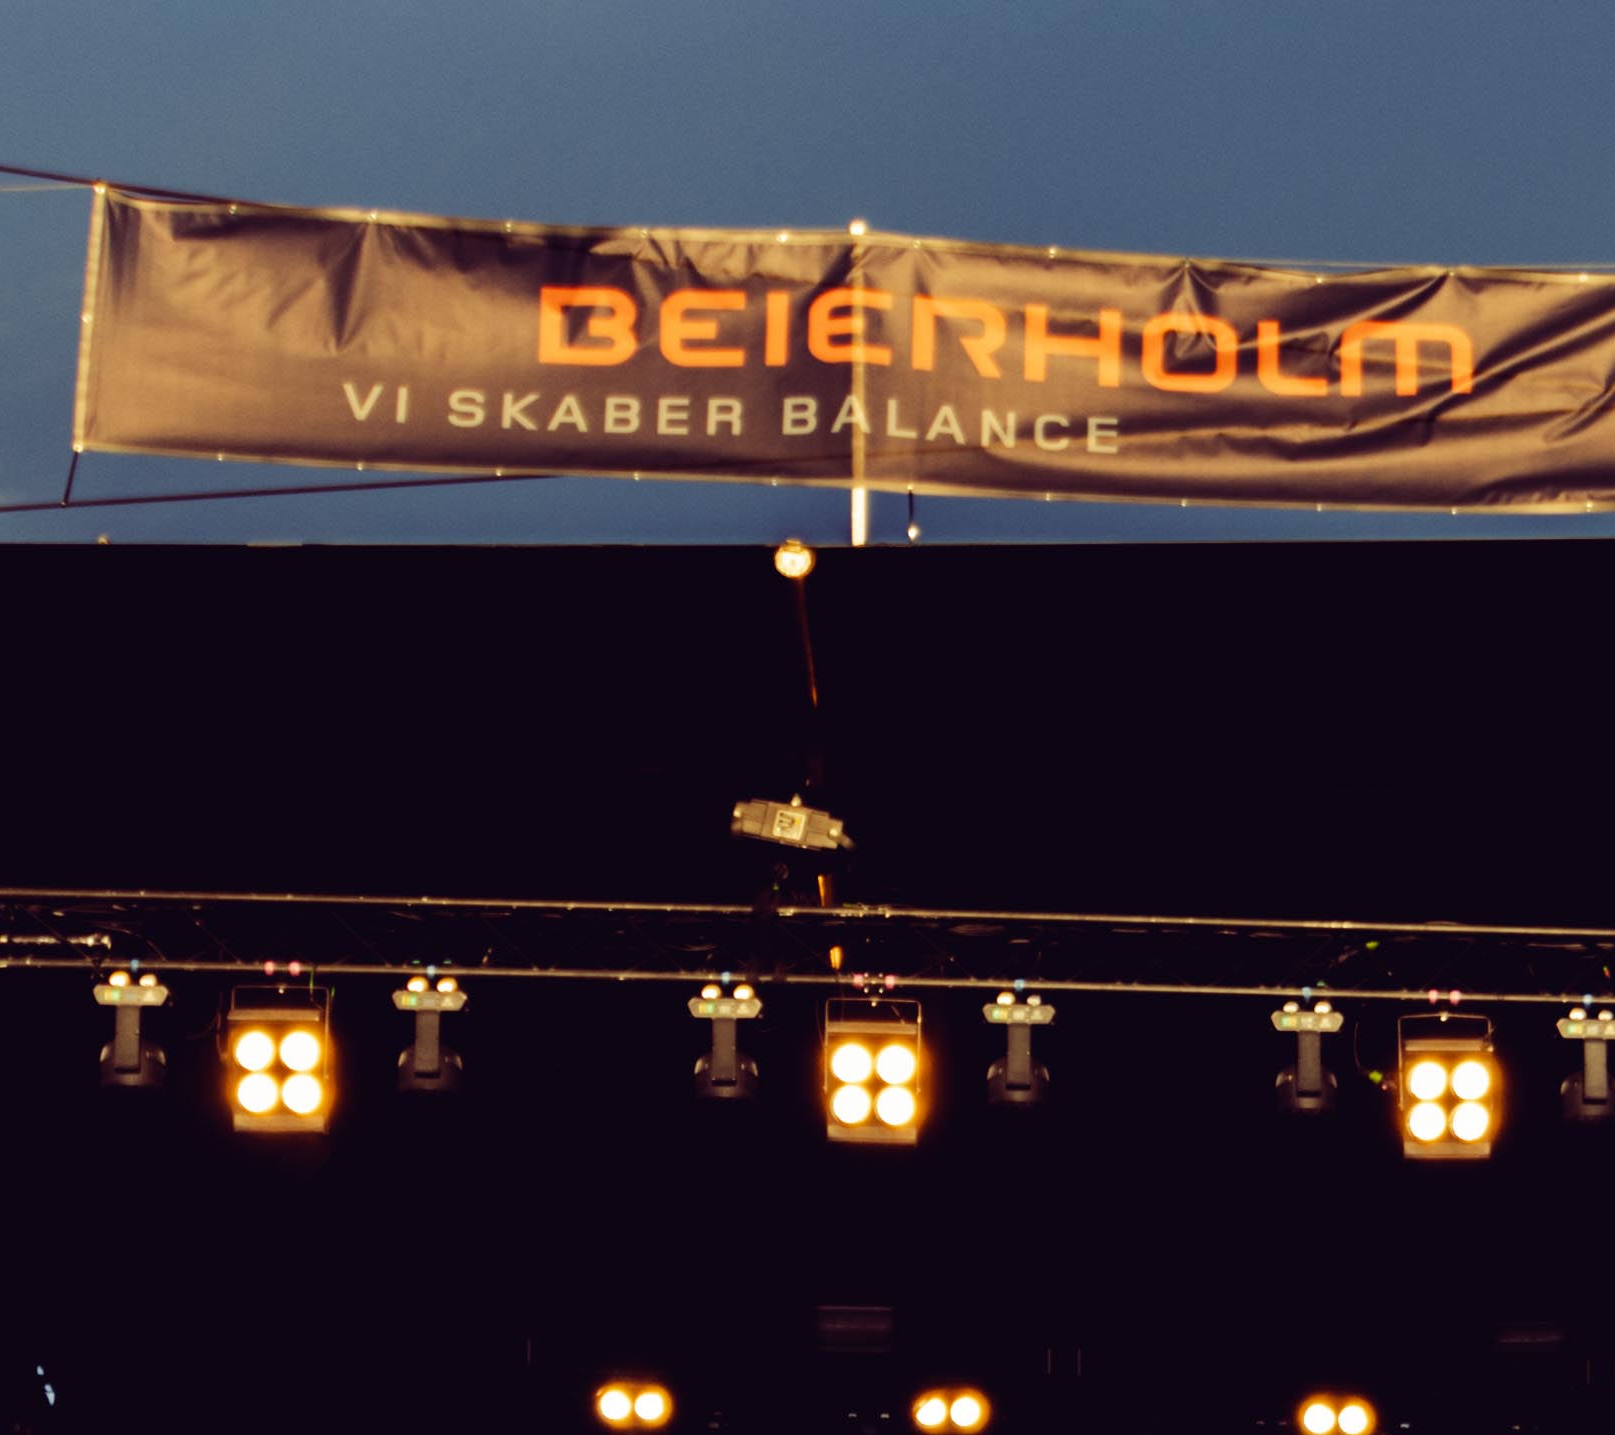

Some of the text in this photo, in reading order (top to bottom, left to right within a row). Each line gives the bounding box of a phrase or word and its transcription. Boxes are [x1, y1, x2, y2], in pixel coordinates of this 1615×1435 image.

[536, 283, 1478, 398] BEIERHOLM
[342, 383, 1122, 456] VI SKABER BALANCE
